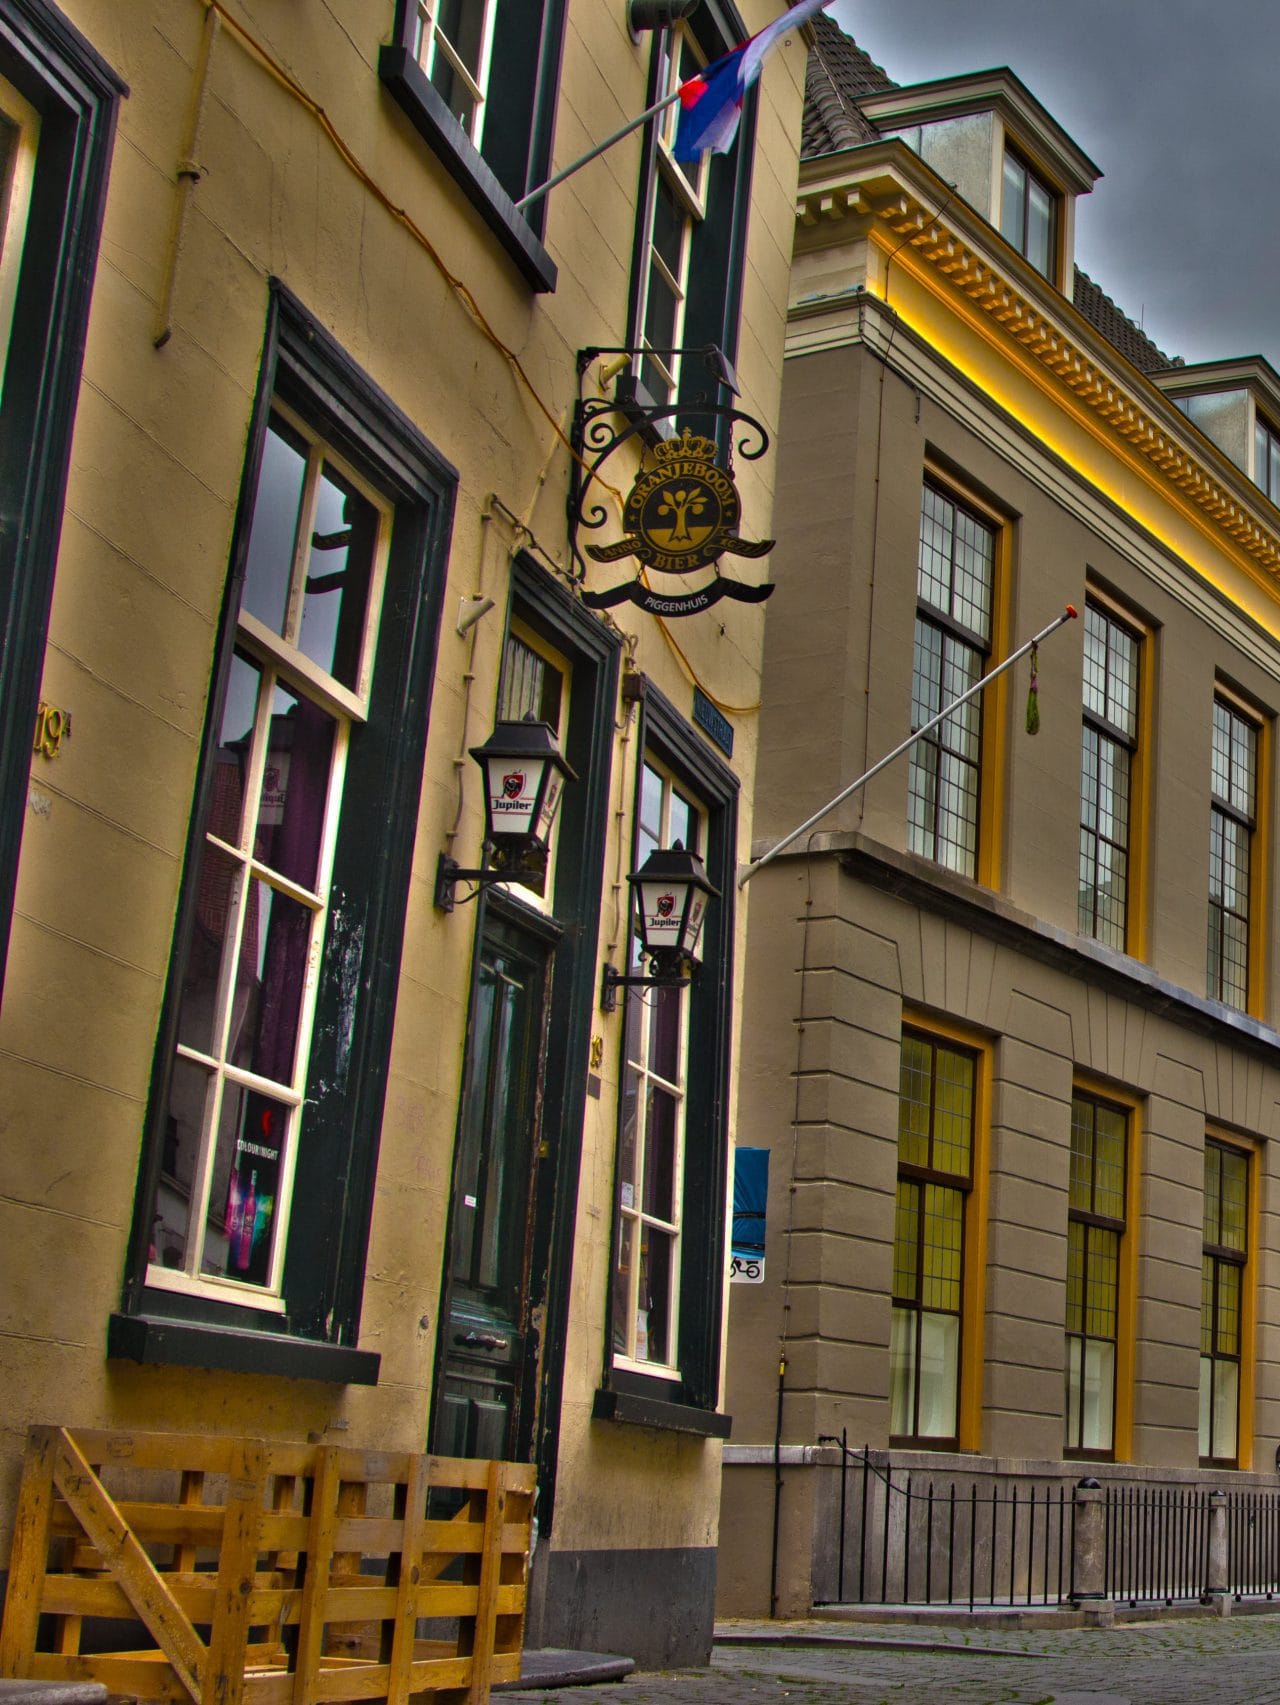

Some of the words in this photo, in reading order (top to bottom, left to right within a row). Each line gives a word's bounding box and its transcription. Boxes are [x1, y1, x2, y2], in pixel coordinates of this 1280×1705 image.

[630, 462, 736, 510] ORANJEBOOM
[603, 541, 641, 558] ANNO
[653, 553, 699, 570] BIER
[644, 595, 709, 612] PIGGENHUIS
[493, 800, 532, 811] Jupiler
[649, 917, 680, 928] Jupiler
